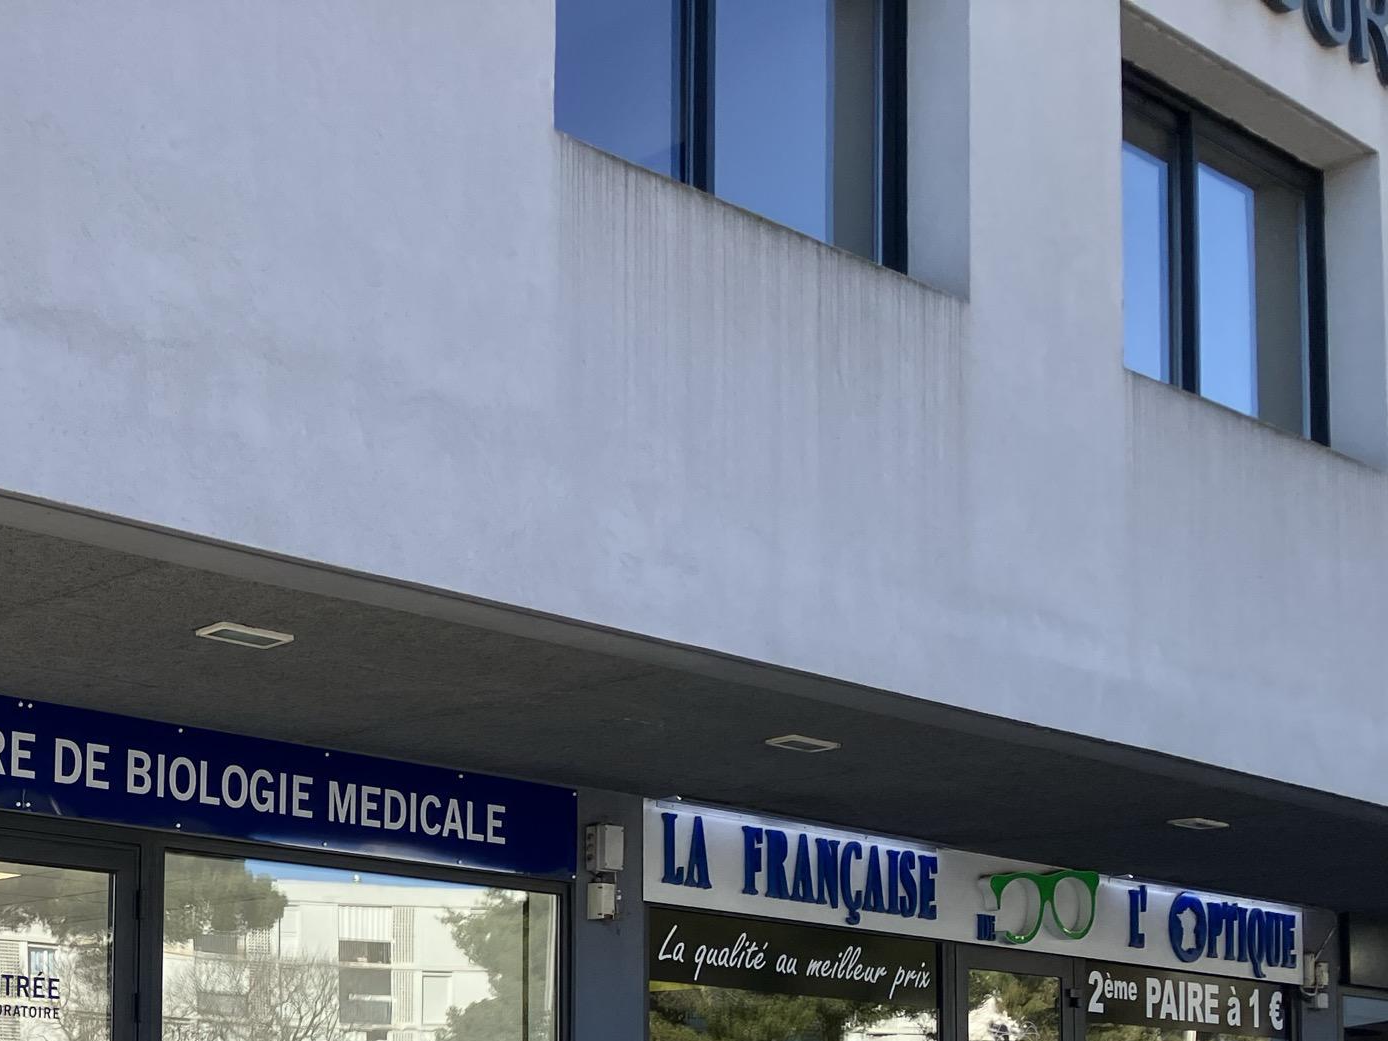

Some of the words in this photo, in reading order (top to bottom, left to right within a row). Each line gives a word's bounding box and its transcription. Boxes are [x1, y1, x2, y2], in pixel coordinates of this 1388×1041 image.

[54, 737, 110, 790] DE
[126, 748, 314, 819] BIOLOGIE
[328, 780, 506, 845] MEDICALE
[662, 812, 712, 889] LA
[742, 825, 938, 925] FRANÇAISE
[658, 924, 685, 964] La
[694, 932, 768, 981] qualité
[775, 953, 798, 975] au
[806, 946, 888, 984] meilleur
[889, 961, 932, 1000] prix
[976, 913, 996, 941] DE
[1088, 970, 1138, 1014] 2ème
[1146, 977, 1220, 1025] PAIRE
[1227, 985, 1242, 1027] à
[1248, 989, 1260, 1028] 1
